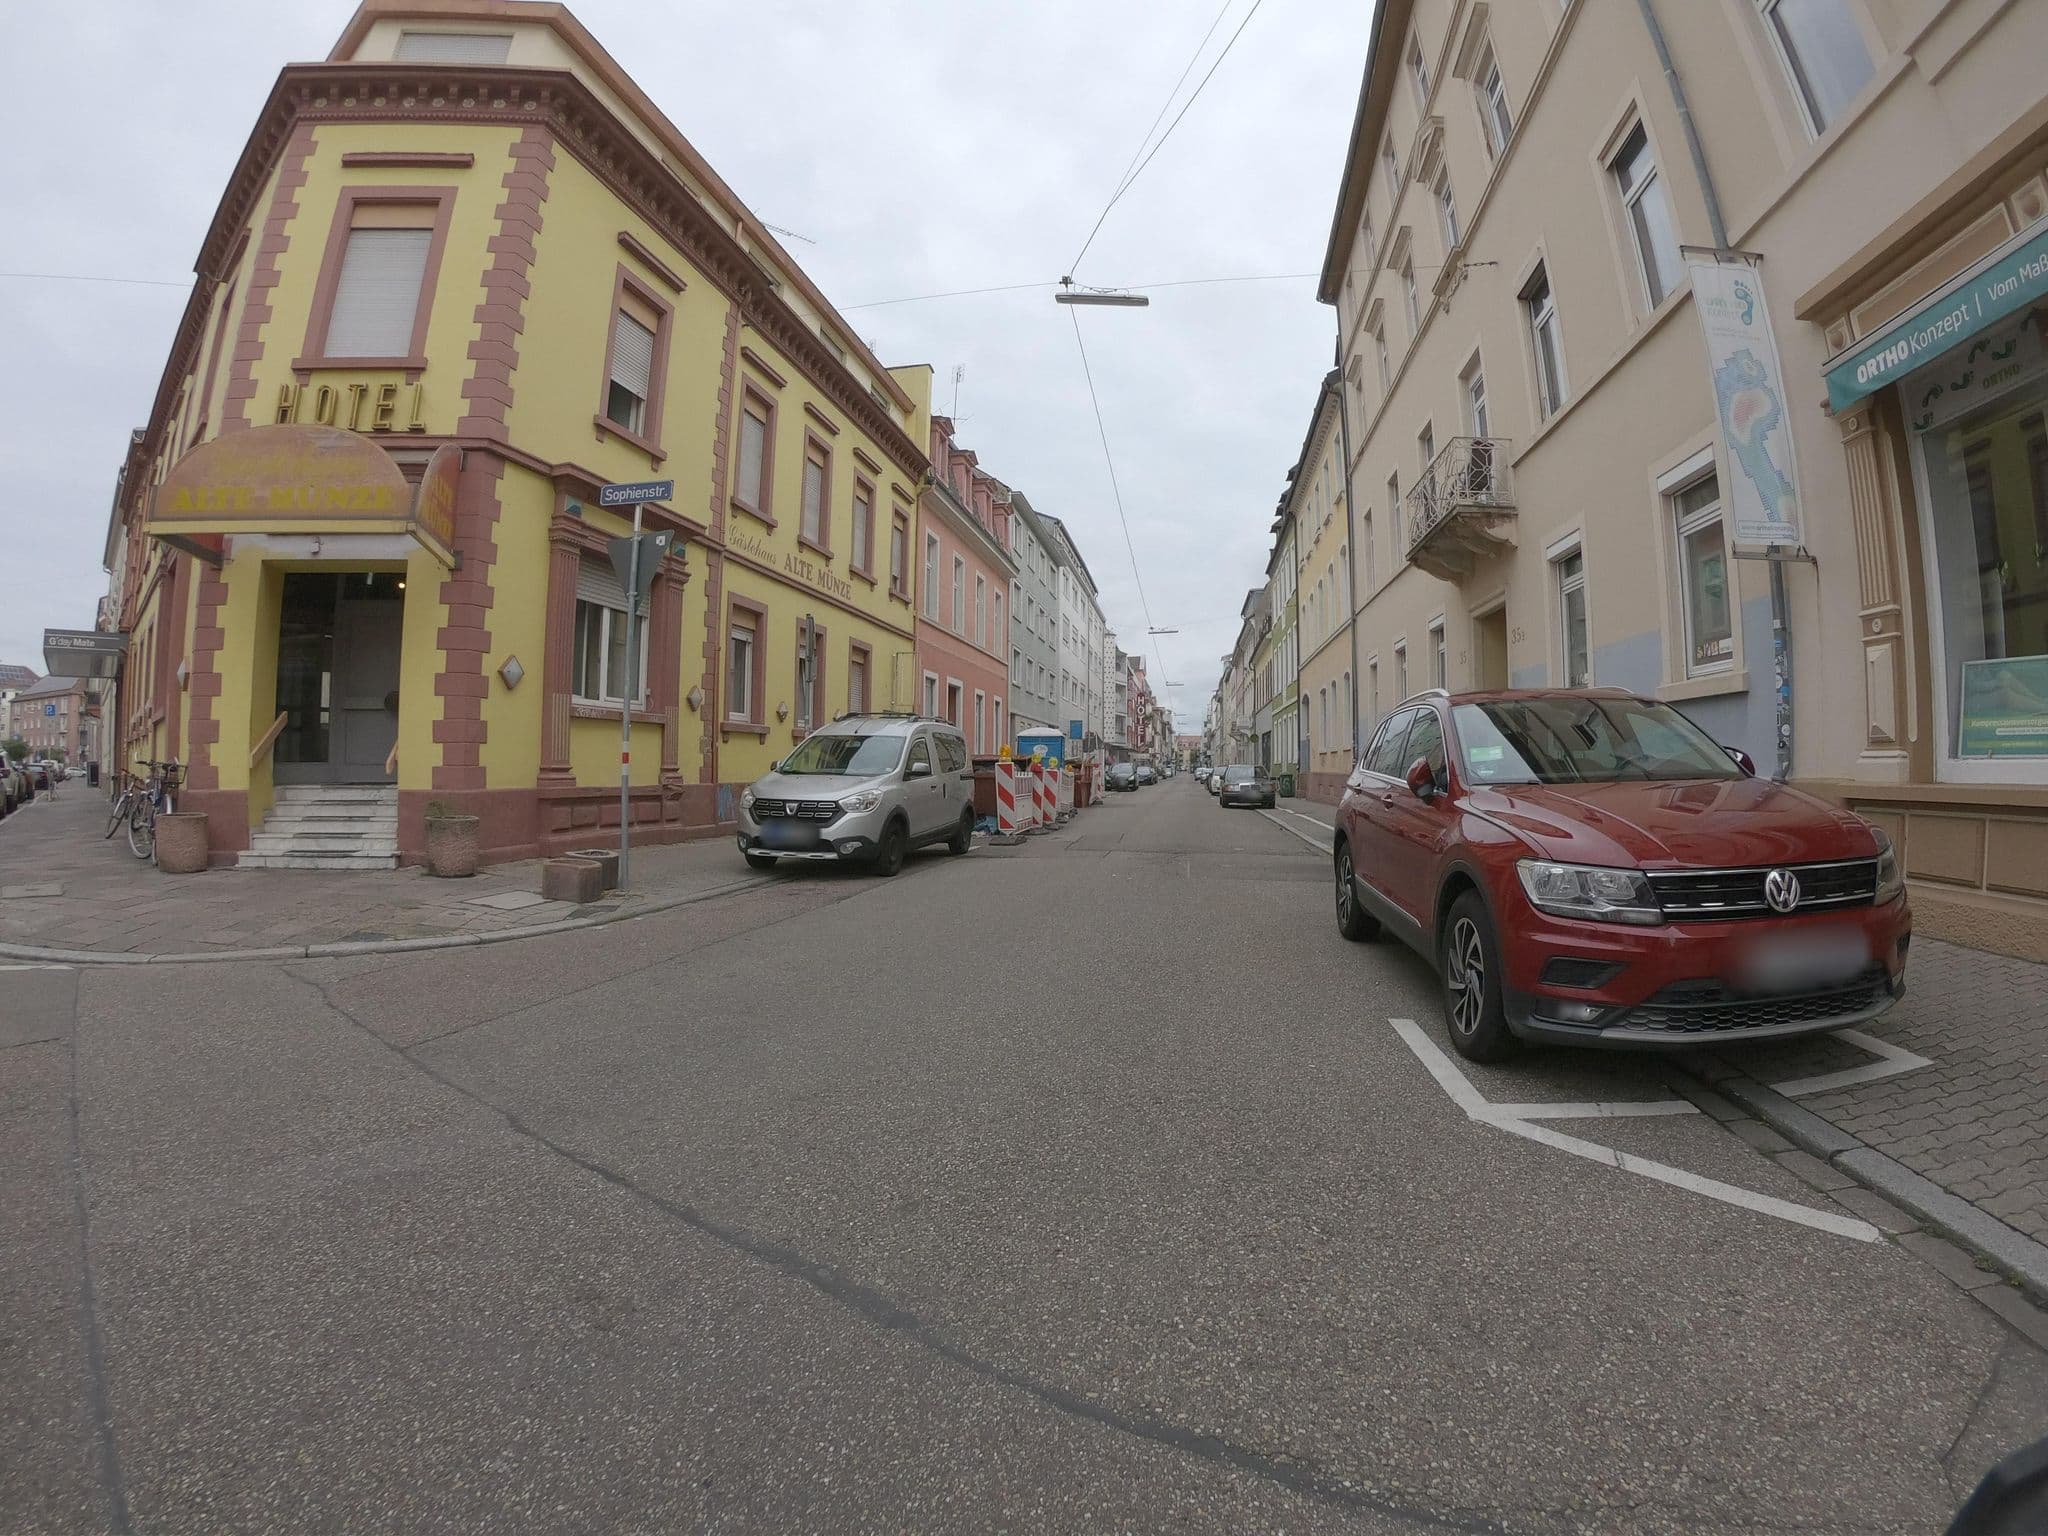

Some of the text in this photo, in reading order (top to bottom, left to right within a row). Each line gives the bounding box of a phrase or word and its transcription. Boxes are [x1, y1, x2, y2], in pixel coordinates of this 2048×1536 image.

[1987, 276, 2018, 301] Vom
[276, 381, 426, 432] HOTEL
[604, 484, 669, 502] Sophienstr.
[728, 523, 852, 600] Gästehaus ALTE MÜNZE
[73, 638, 96, 648] Mate
[1137, 695, 1146, 747] HOTEL
